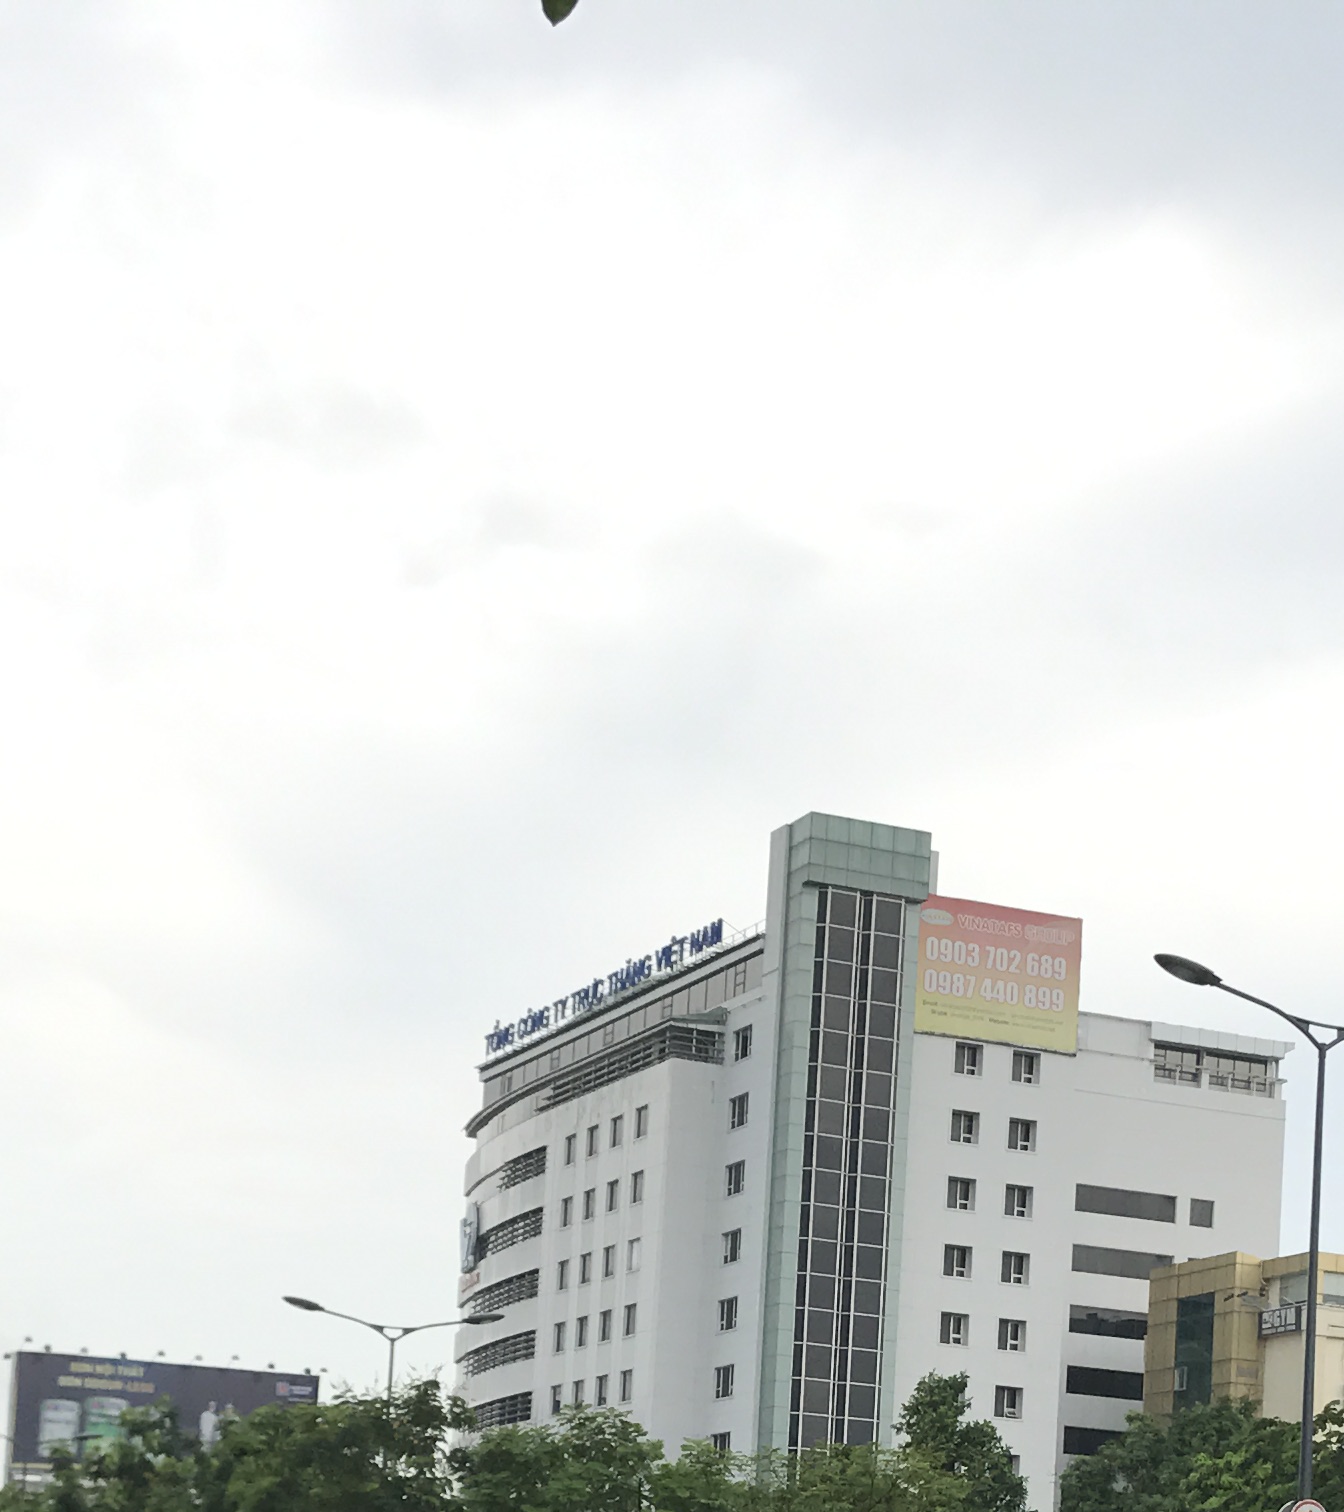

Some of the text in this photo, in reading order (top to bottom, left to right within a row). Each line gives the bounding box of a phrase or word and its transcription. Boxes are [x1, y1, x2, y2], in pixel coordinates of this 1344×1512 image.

[958, 914, 1022, 938] VINATAFS
[552, 995, 570, 1023] TY
[690, 917, 723, 957] NAM
[926, 936, 1067, 981] 0903 702 689
[923, 968, 976, 998] 0987
[979, 977, 1019, 1005] 440
[1023, 984, 1065, 1012] 899
